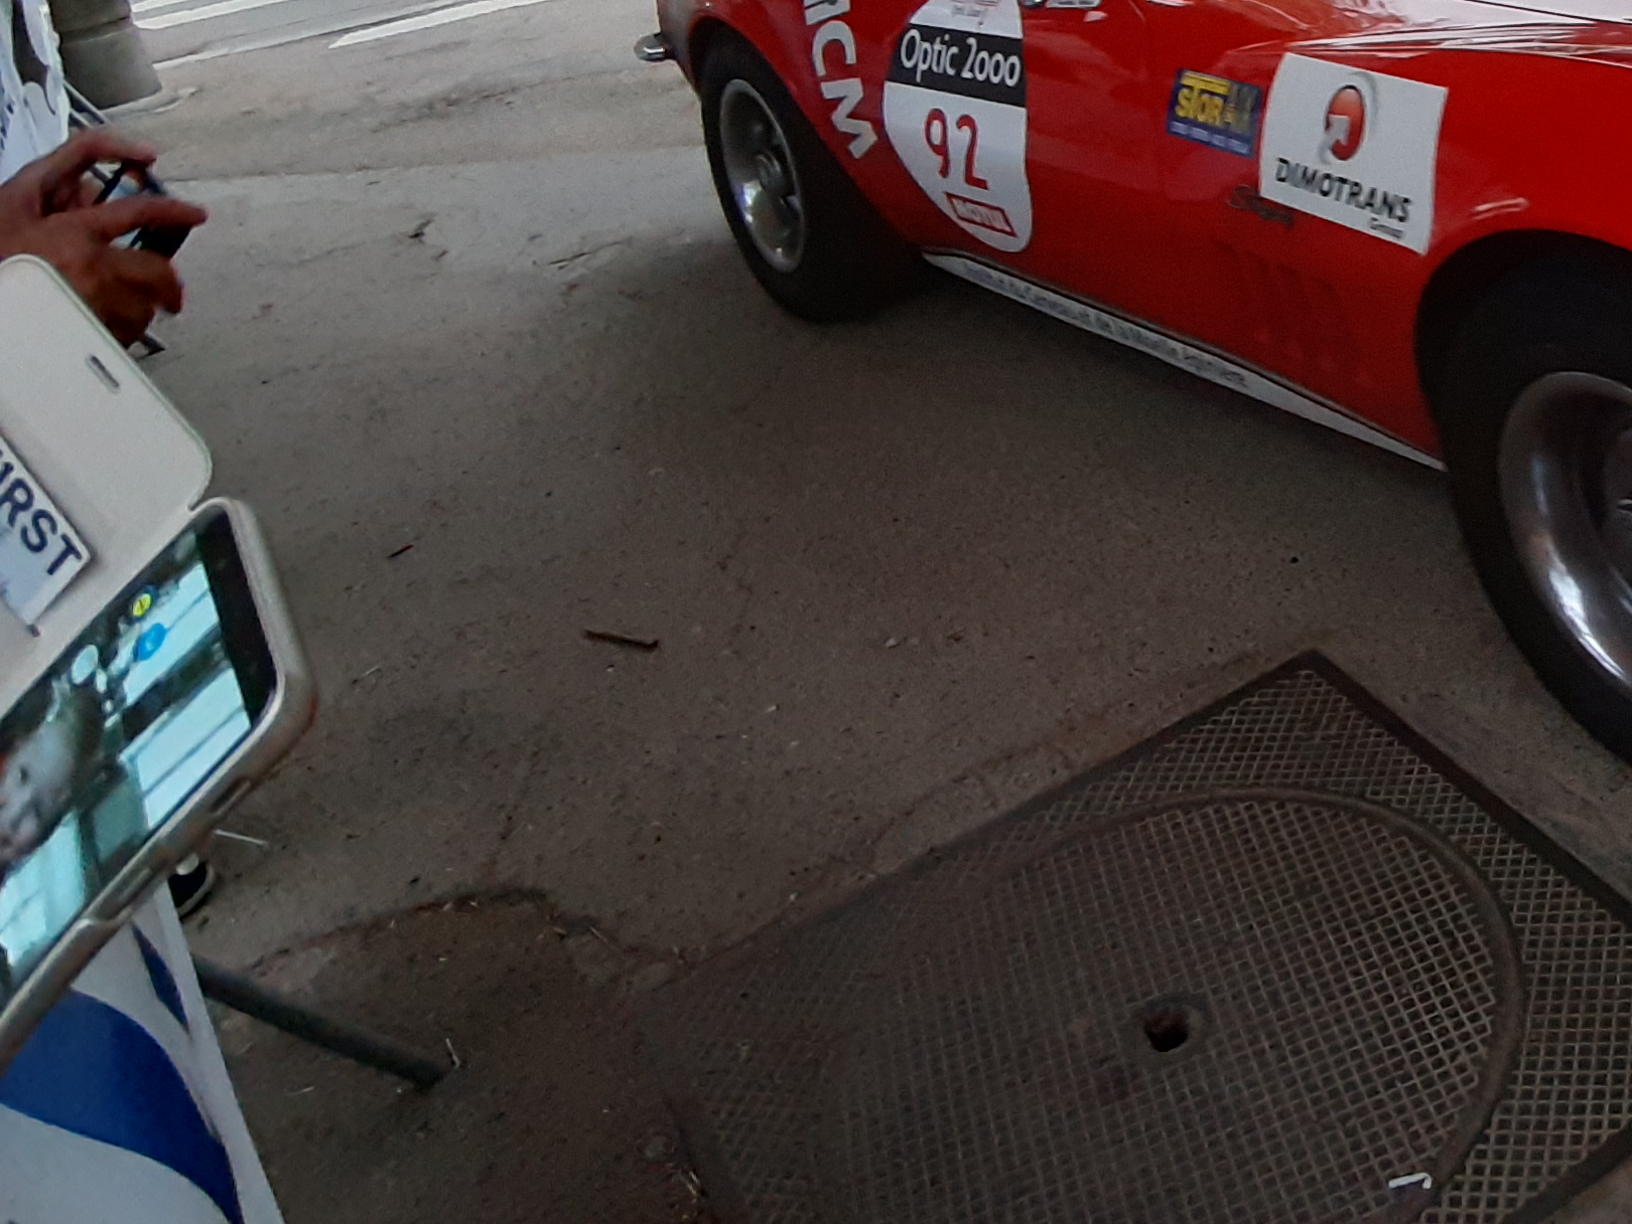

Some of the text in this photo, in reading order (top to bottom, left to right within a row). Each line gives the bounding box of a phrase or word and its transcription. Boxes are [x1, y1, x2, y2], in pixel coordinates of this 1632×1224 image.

[901, 28, 1021, 87] Optic 2000
[924, 107, 990, 191] 92
[1274, 157, 1412, 223] DIMOTRANS
